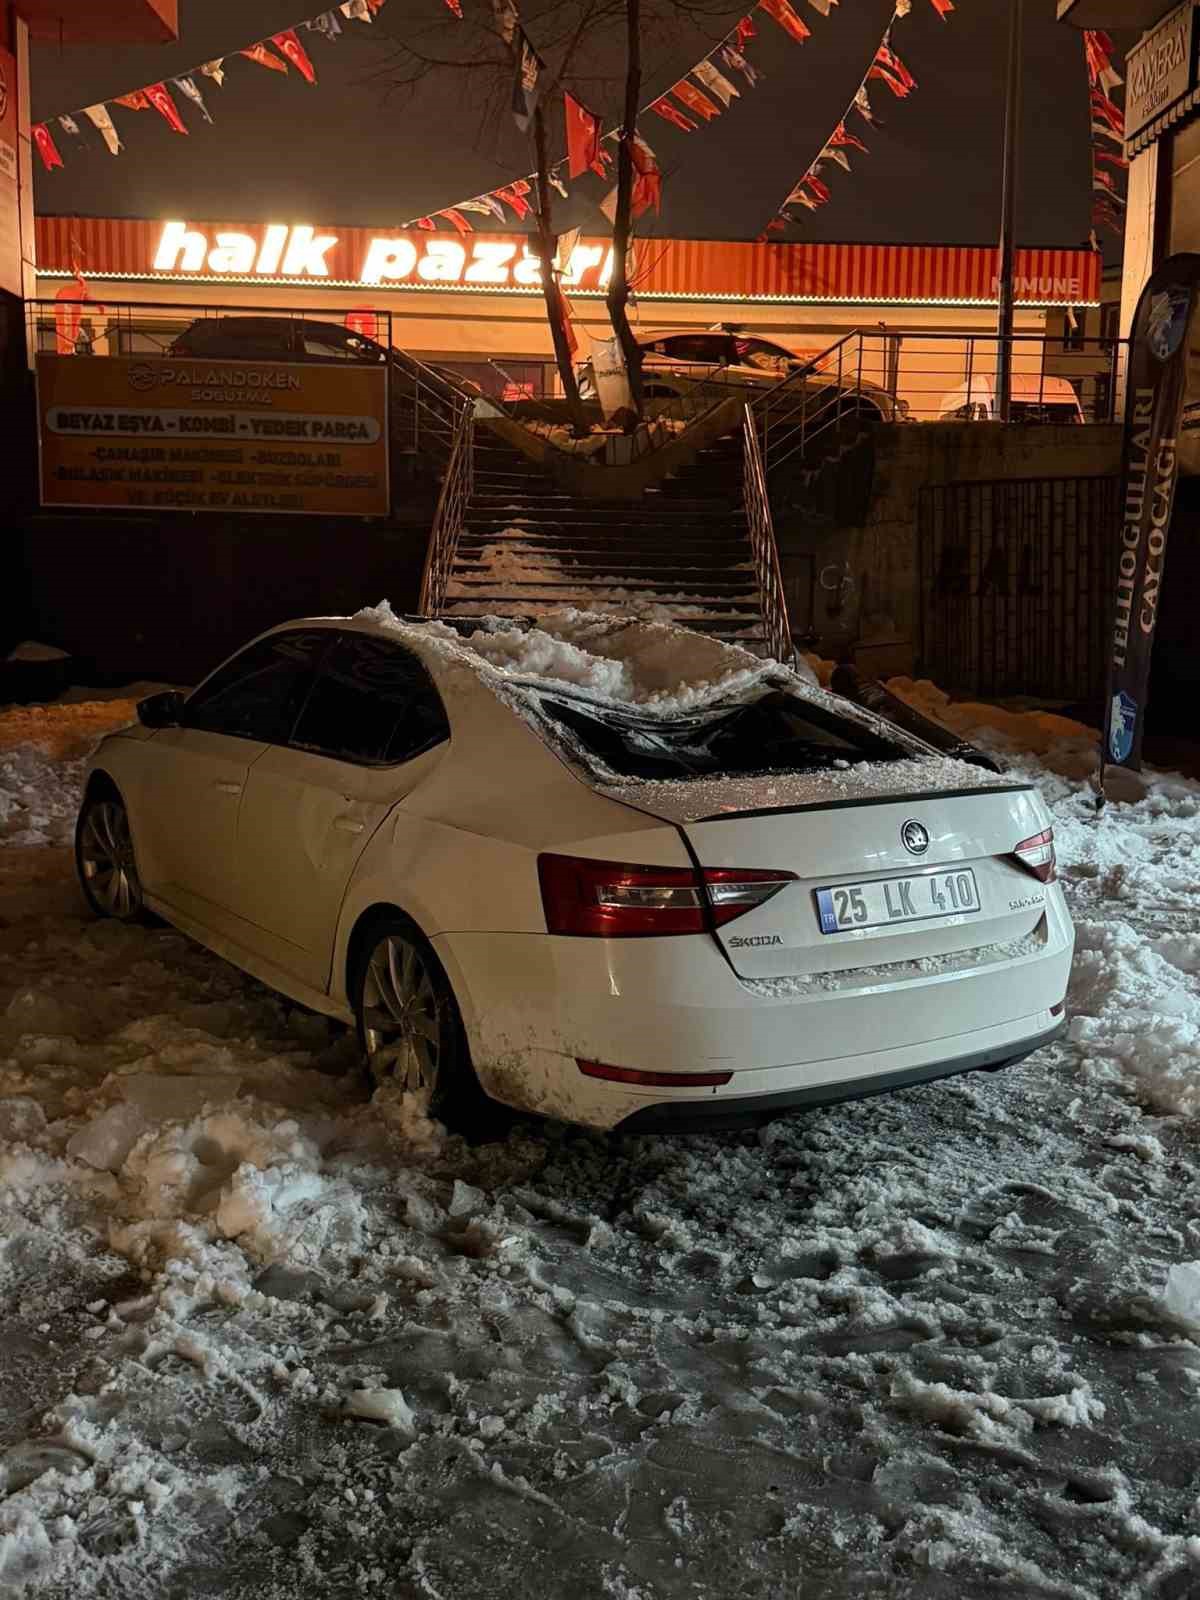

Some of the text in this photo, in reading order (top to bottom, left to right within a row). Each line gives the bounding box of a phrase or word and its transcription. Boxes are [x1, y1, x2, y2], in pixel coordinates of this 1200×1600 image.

[152, 220, 339, 277] halk
[56, 412, 115, 430] BEYAZ
[823, 913, 836, 925] TR
[834, 887, 868, 925] 25
[883, 880, 917, 919] LK
[929, 873, 974, 911] 410
